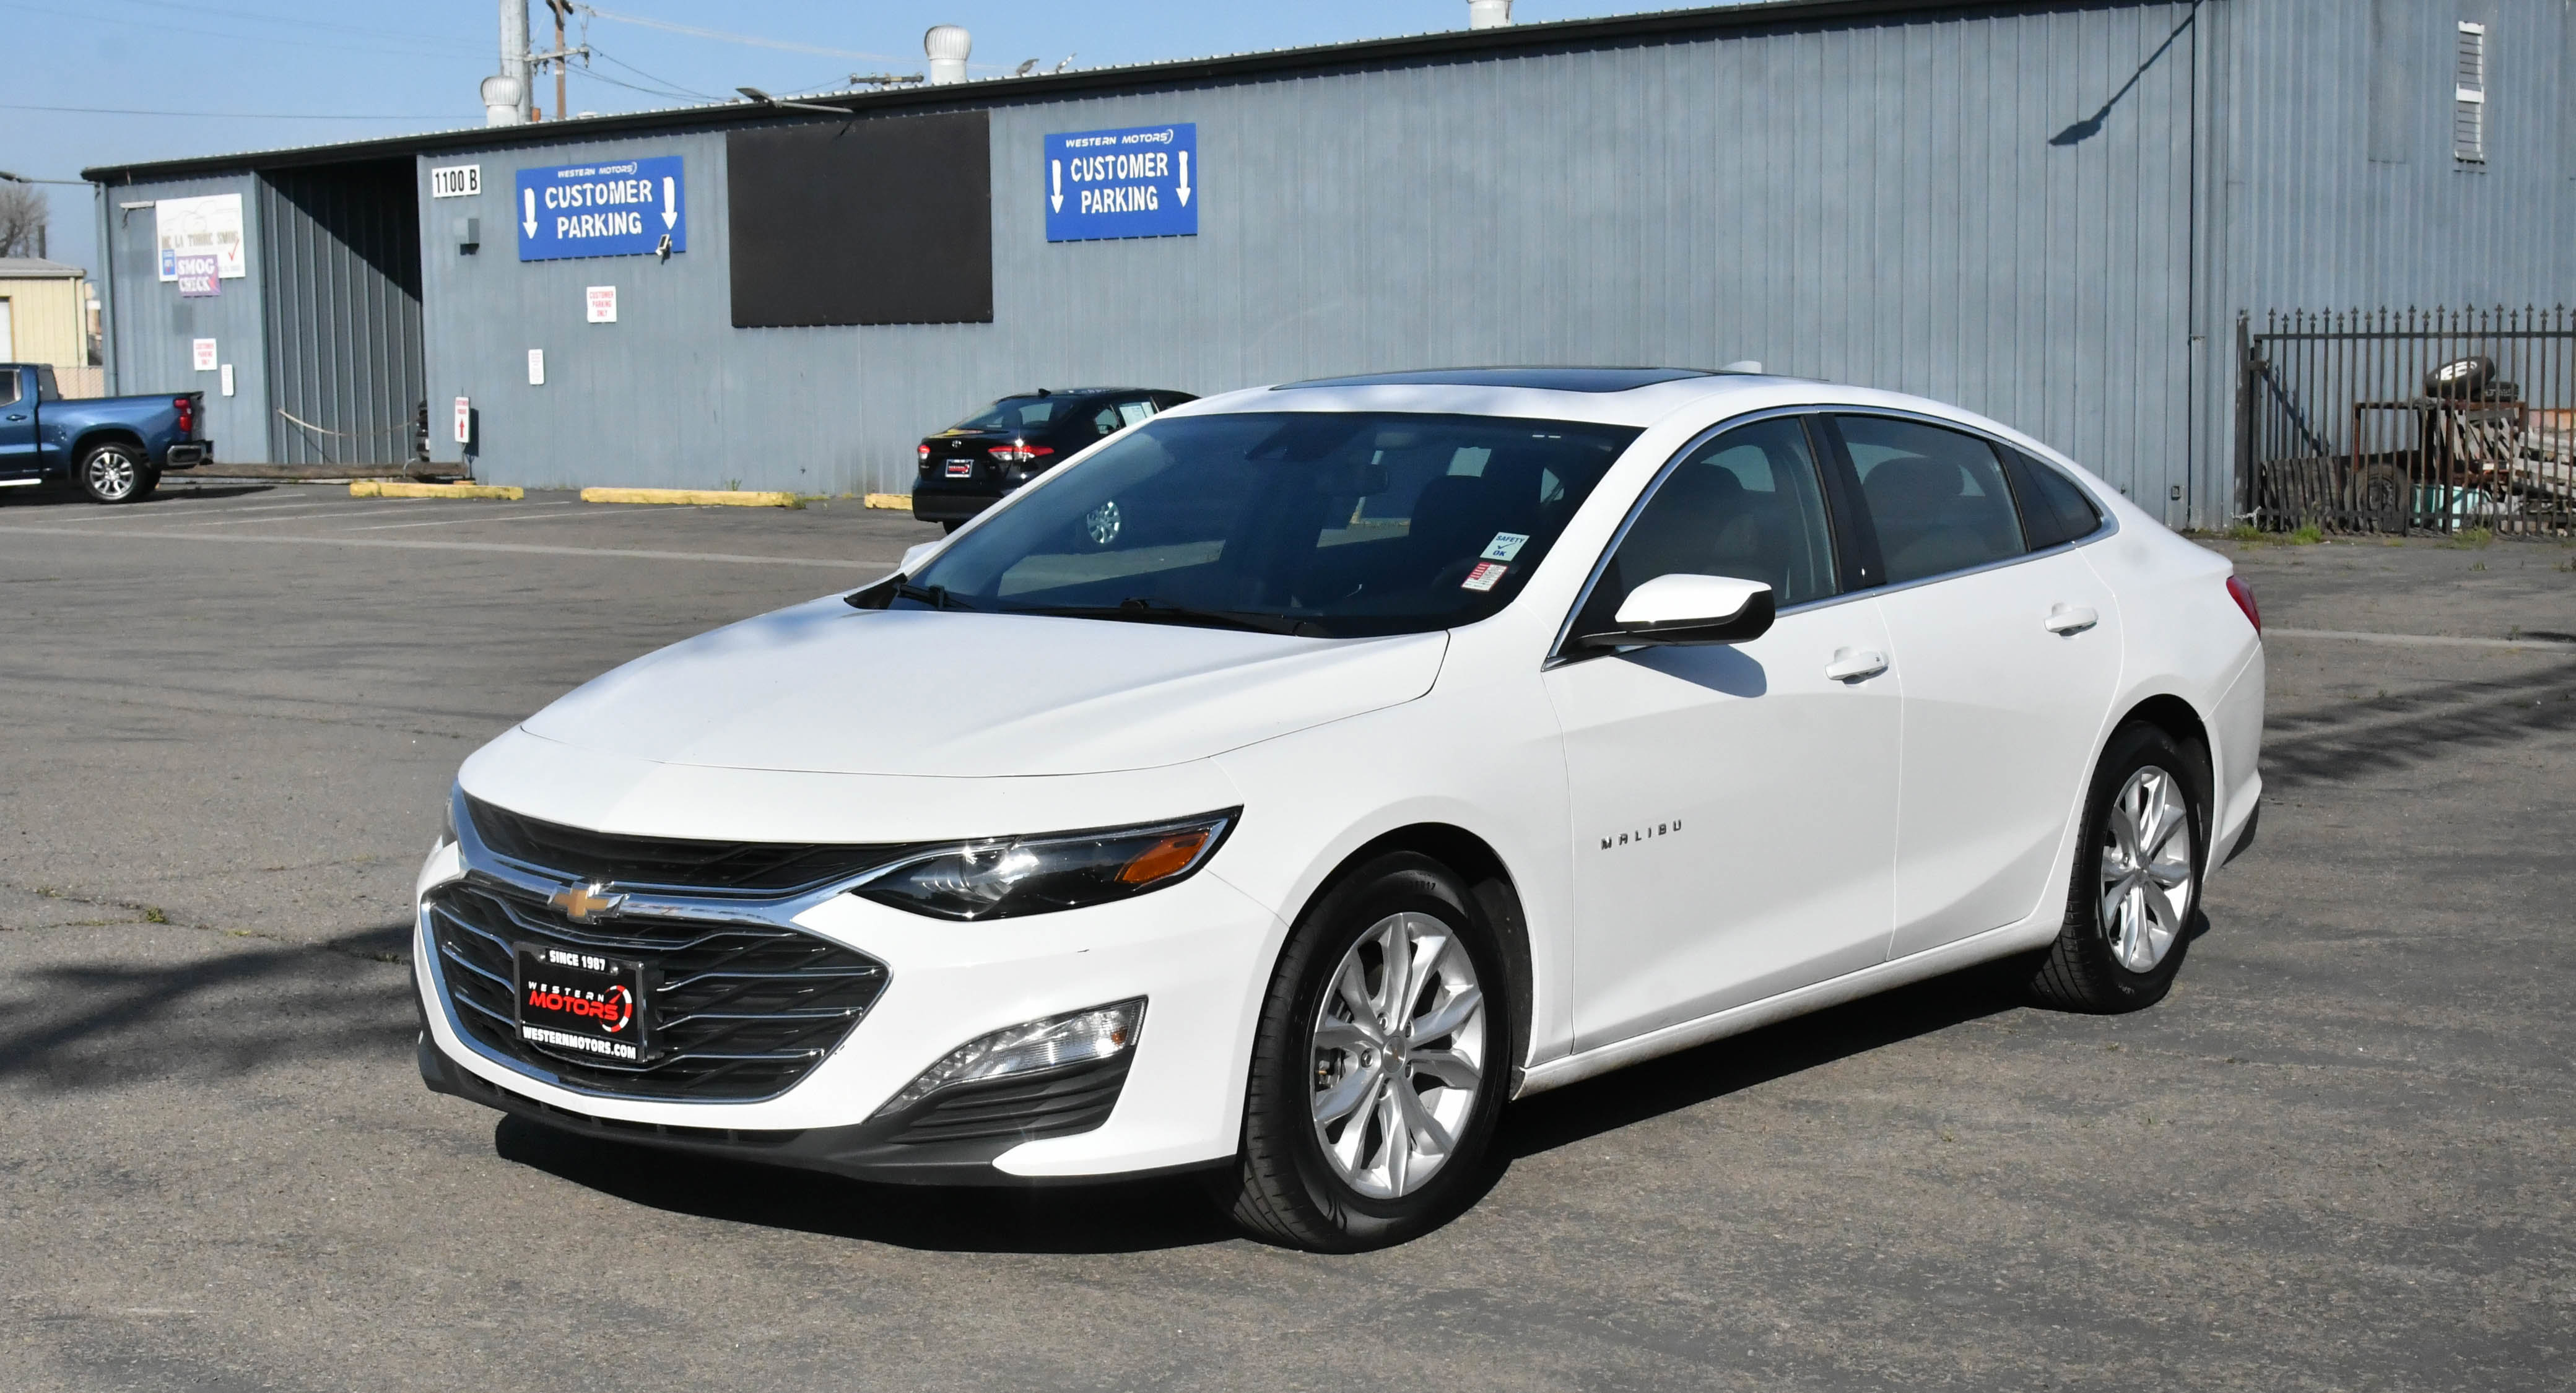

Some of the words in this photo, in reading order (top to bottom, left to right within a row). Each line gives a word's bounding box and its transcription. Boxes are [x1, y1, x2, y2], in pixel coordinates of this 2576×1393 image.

[1066, 136, 1116, 148] WESTERN
[1121, 132, 1167, 144] MOTORS
[558, 168, 595, 178] WESTERN
[599, 164, 633, 175] MOTORS
[1071, 152, 1168, 182] CUSTOMER
[435, 170, 464, 193] 1100
[469, 169, 477, 191] B
[545, 180, 653, 209] CUSTOMER
[1081, 185, 1159, 214] PARKING
[557, 211, 642, 239] PARKING
[177, 258, 215, 276] SMOG
[179, 276, 211, 292] CHECK
[1495, 535, 1525, 544] SAFETY
[1601, 819, 1682, 850] MALIBU
[549, 950, 579, 966] SINCE
[581, 955, 606, 971] 1987
[528, 981, 605, 1002] WESTERN
[529, 991, 619, 1021] MOTORS
[522, 1026, 637, 1059] WESTERNMOTORS.COM
